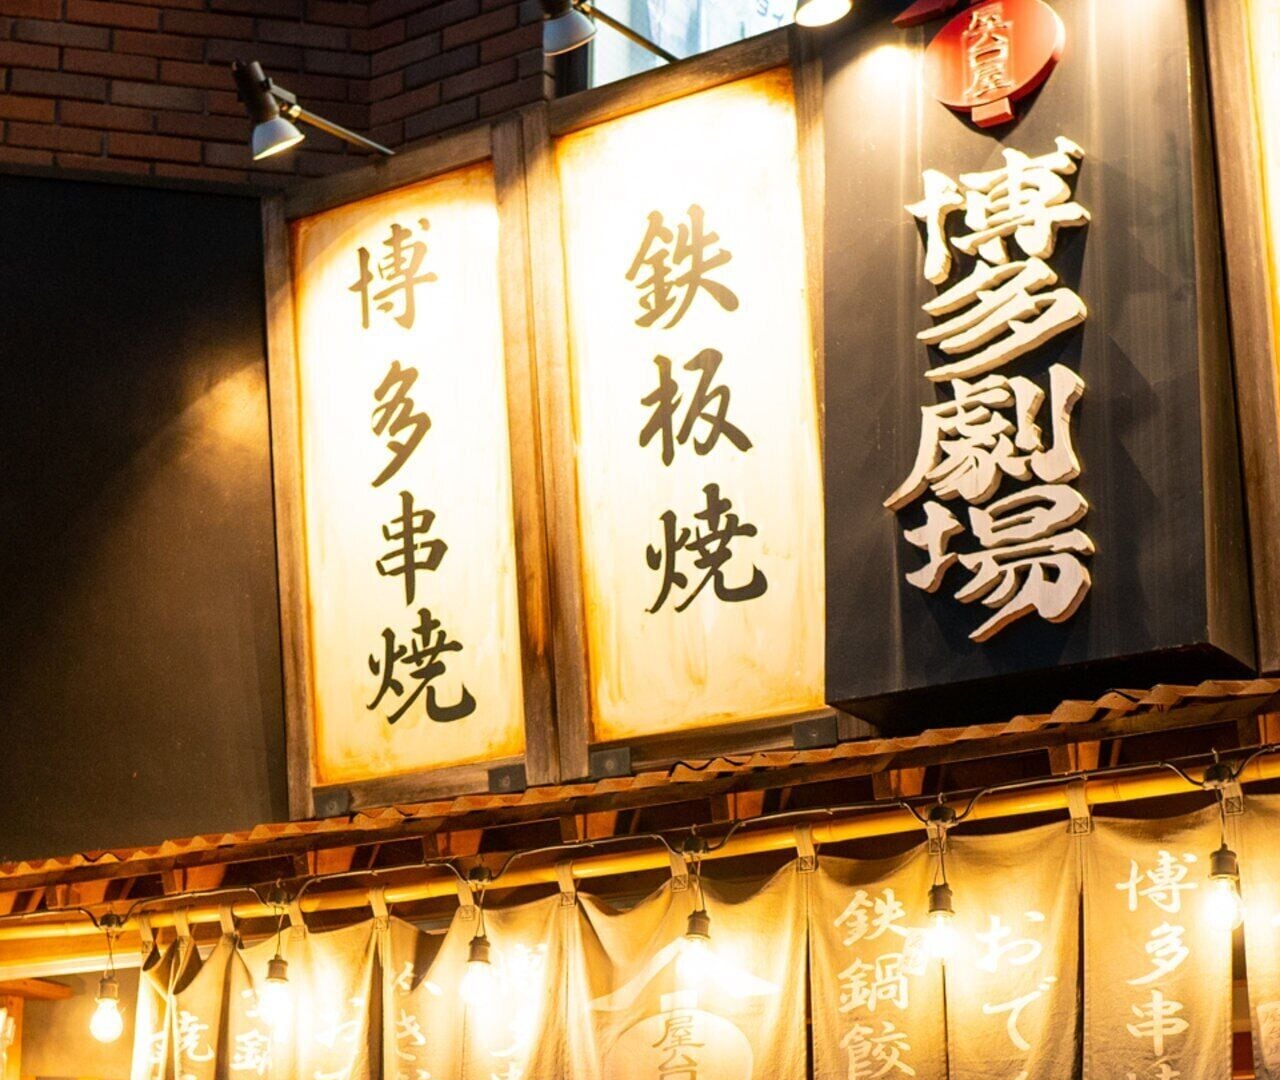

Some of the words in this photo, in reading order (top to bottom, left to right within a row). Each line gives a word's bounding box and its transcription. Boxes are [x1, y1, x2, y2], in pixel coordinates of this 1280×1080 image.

[347, 217, 477, 726] 博多串焼
[624, 203, 769, 615] 鉄板焼
[881, 136, 1096, 644] 博多劇場
